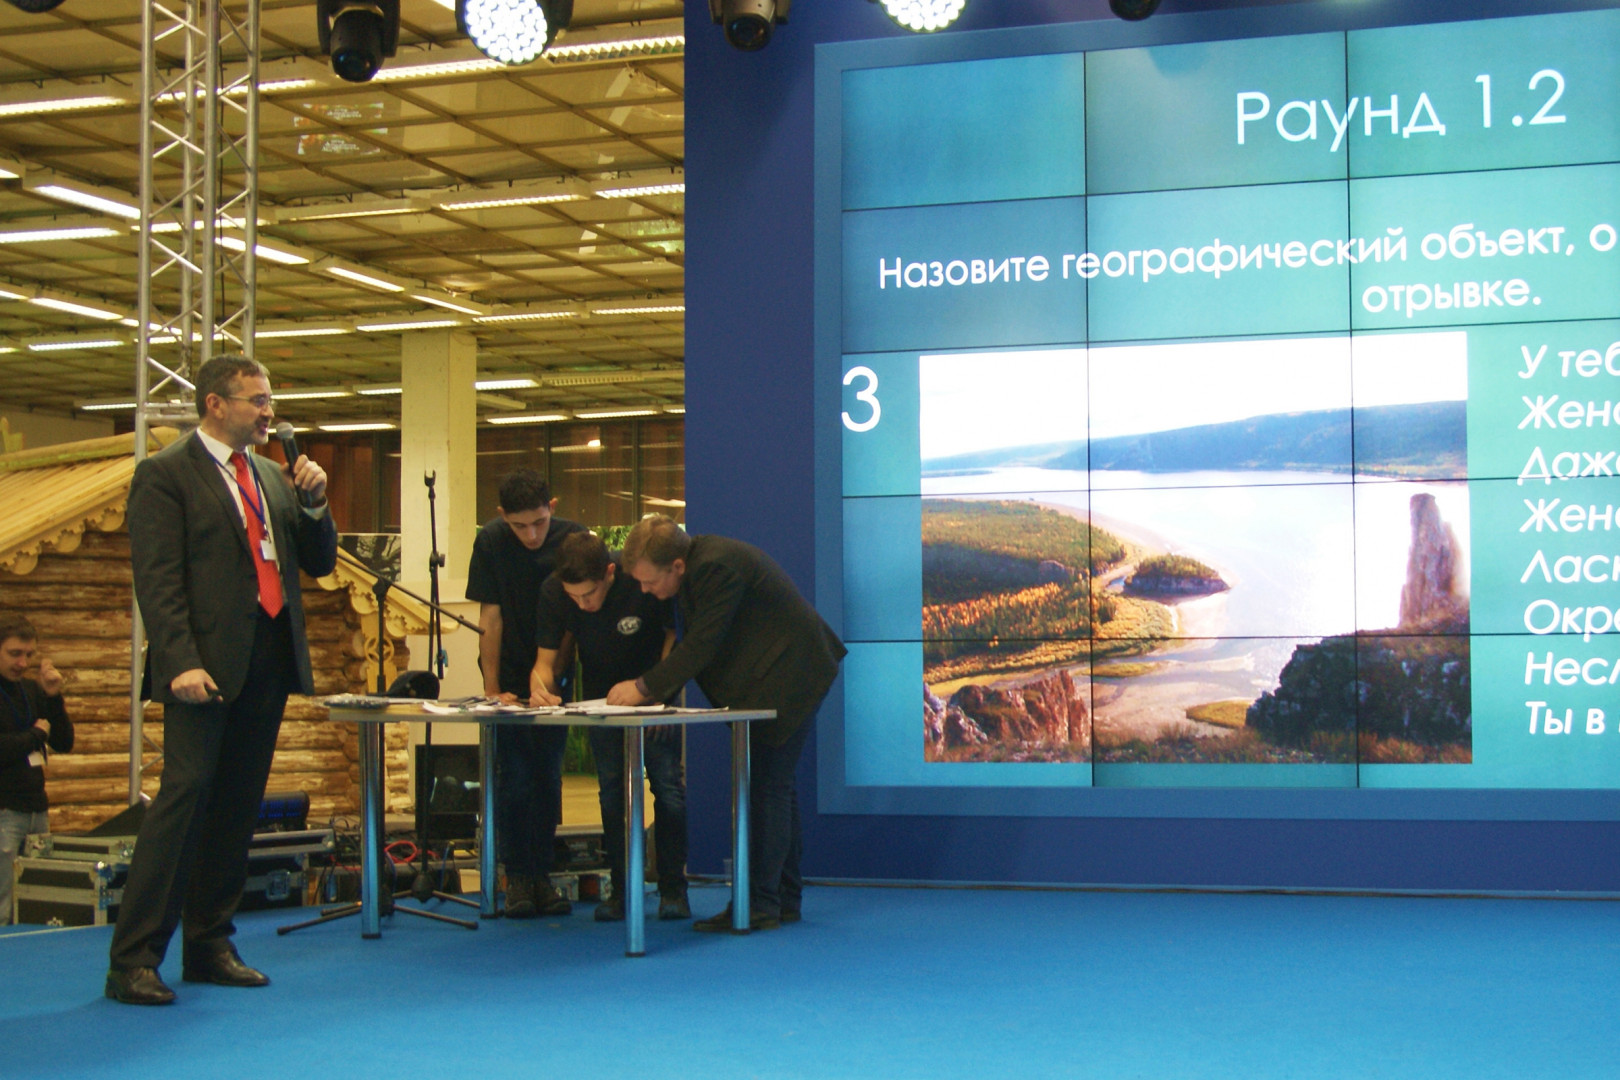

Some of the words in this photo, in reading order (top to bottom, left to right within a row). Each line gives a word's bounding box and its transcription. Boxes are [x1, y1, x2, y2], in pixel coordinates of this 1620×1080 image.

[1237, 91, 1446, 152] Раунд
[1476, 69, 1567, 128] 1.2
[880, 255, 1050, 289] Назовите
[1062, 226, 1407, 283] географический
[1420, 222, 1575, 261] объект,
[1589, 223, 1617, 252] о
[1361, 278, 1542, 319] отрывке.
[841, 366, 881, 432] 3
[1517, 394, 1620, 430] Жен
[1516, 446, 1620, 486] Даж
[1519, 498, 1620, 533] Жен
[1523, 598, 1620, 643] Окр
[1525, 701, 1573, 735] Ты
[1585, 708, 1605, 735] в
